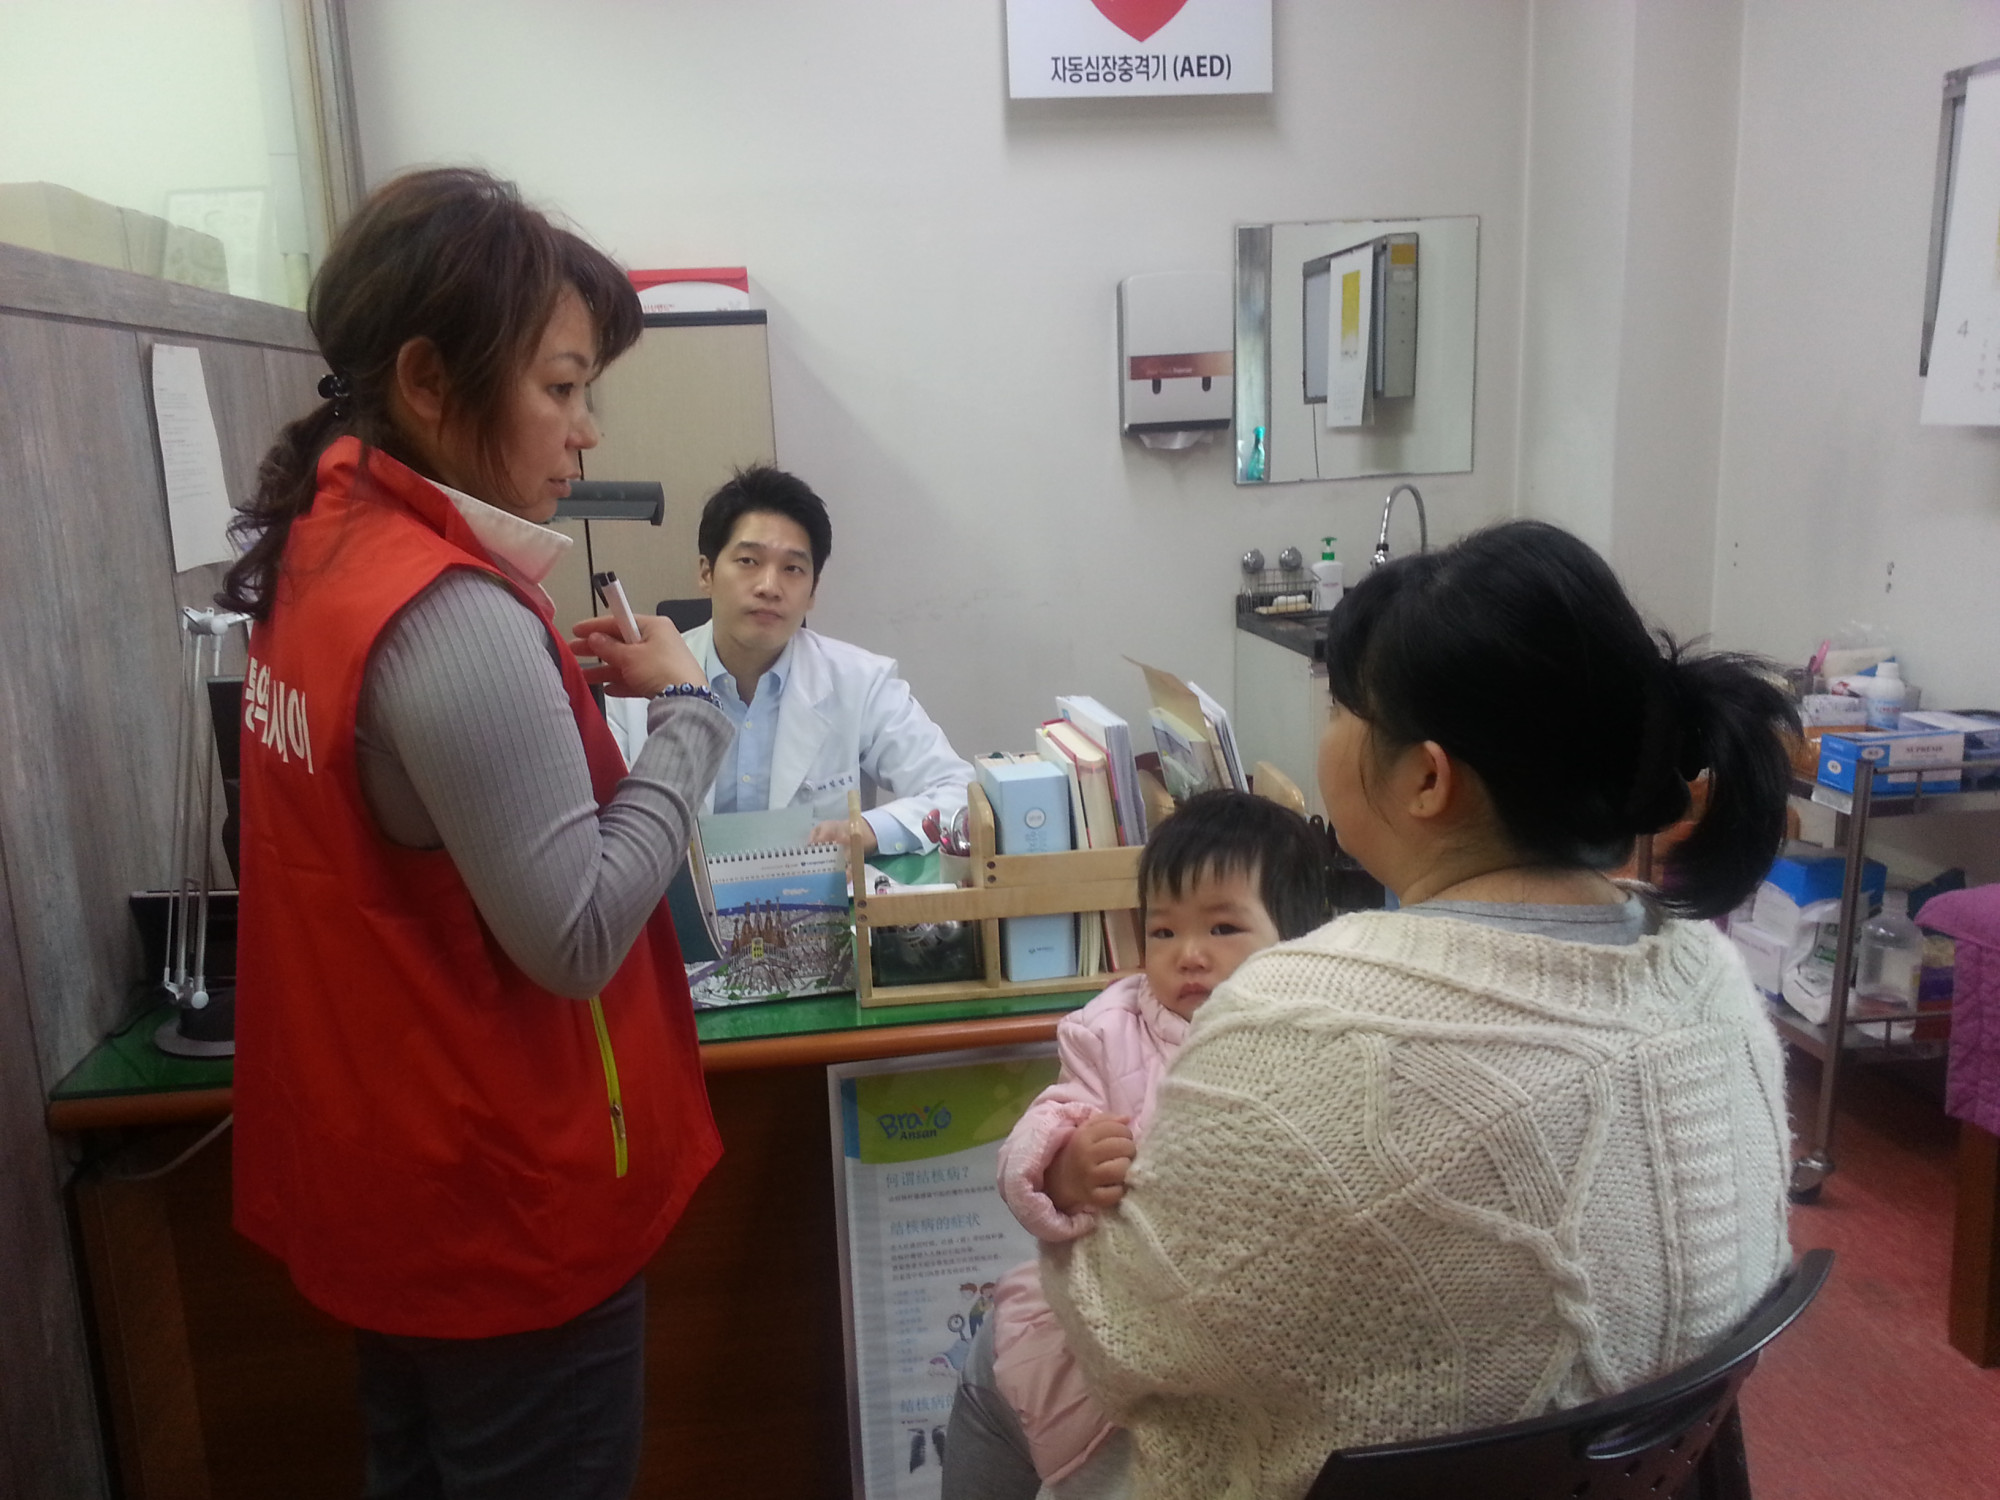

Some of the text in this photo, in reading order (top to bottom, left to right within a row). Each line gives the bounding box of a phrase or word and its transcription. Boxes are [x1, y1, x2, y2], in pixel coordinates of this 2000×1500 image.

[1051, 54, 1233, 83] 자동심장충격기 (AED)
[900, 1129, 938, 1141] Ansan
